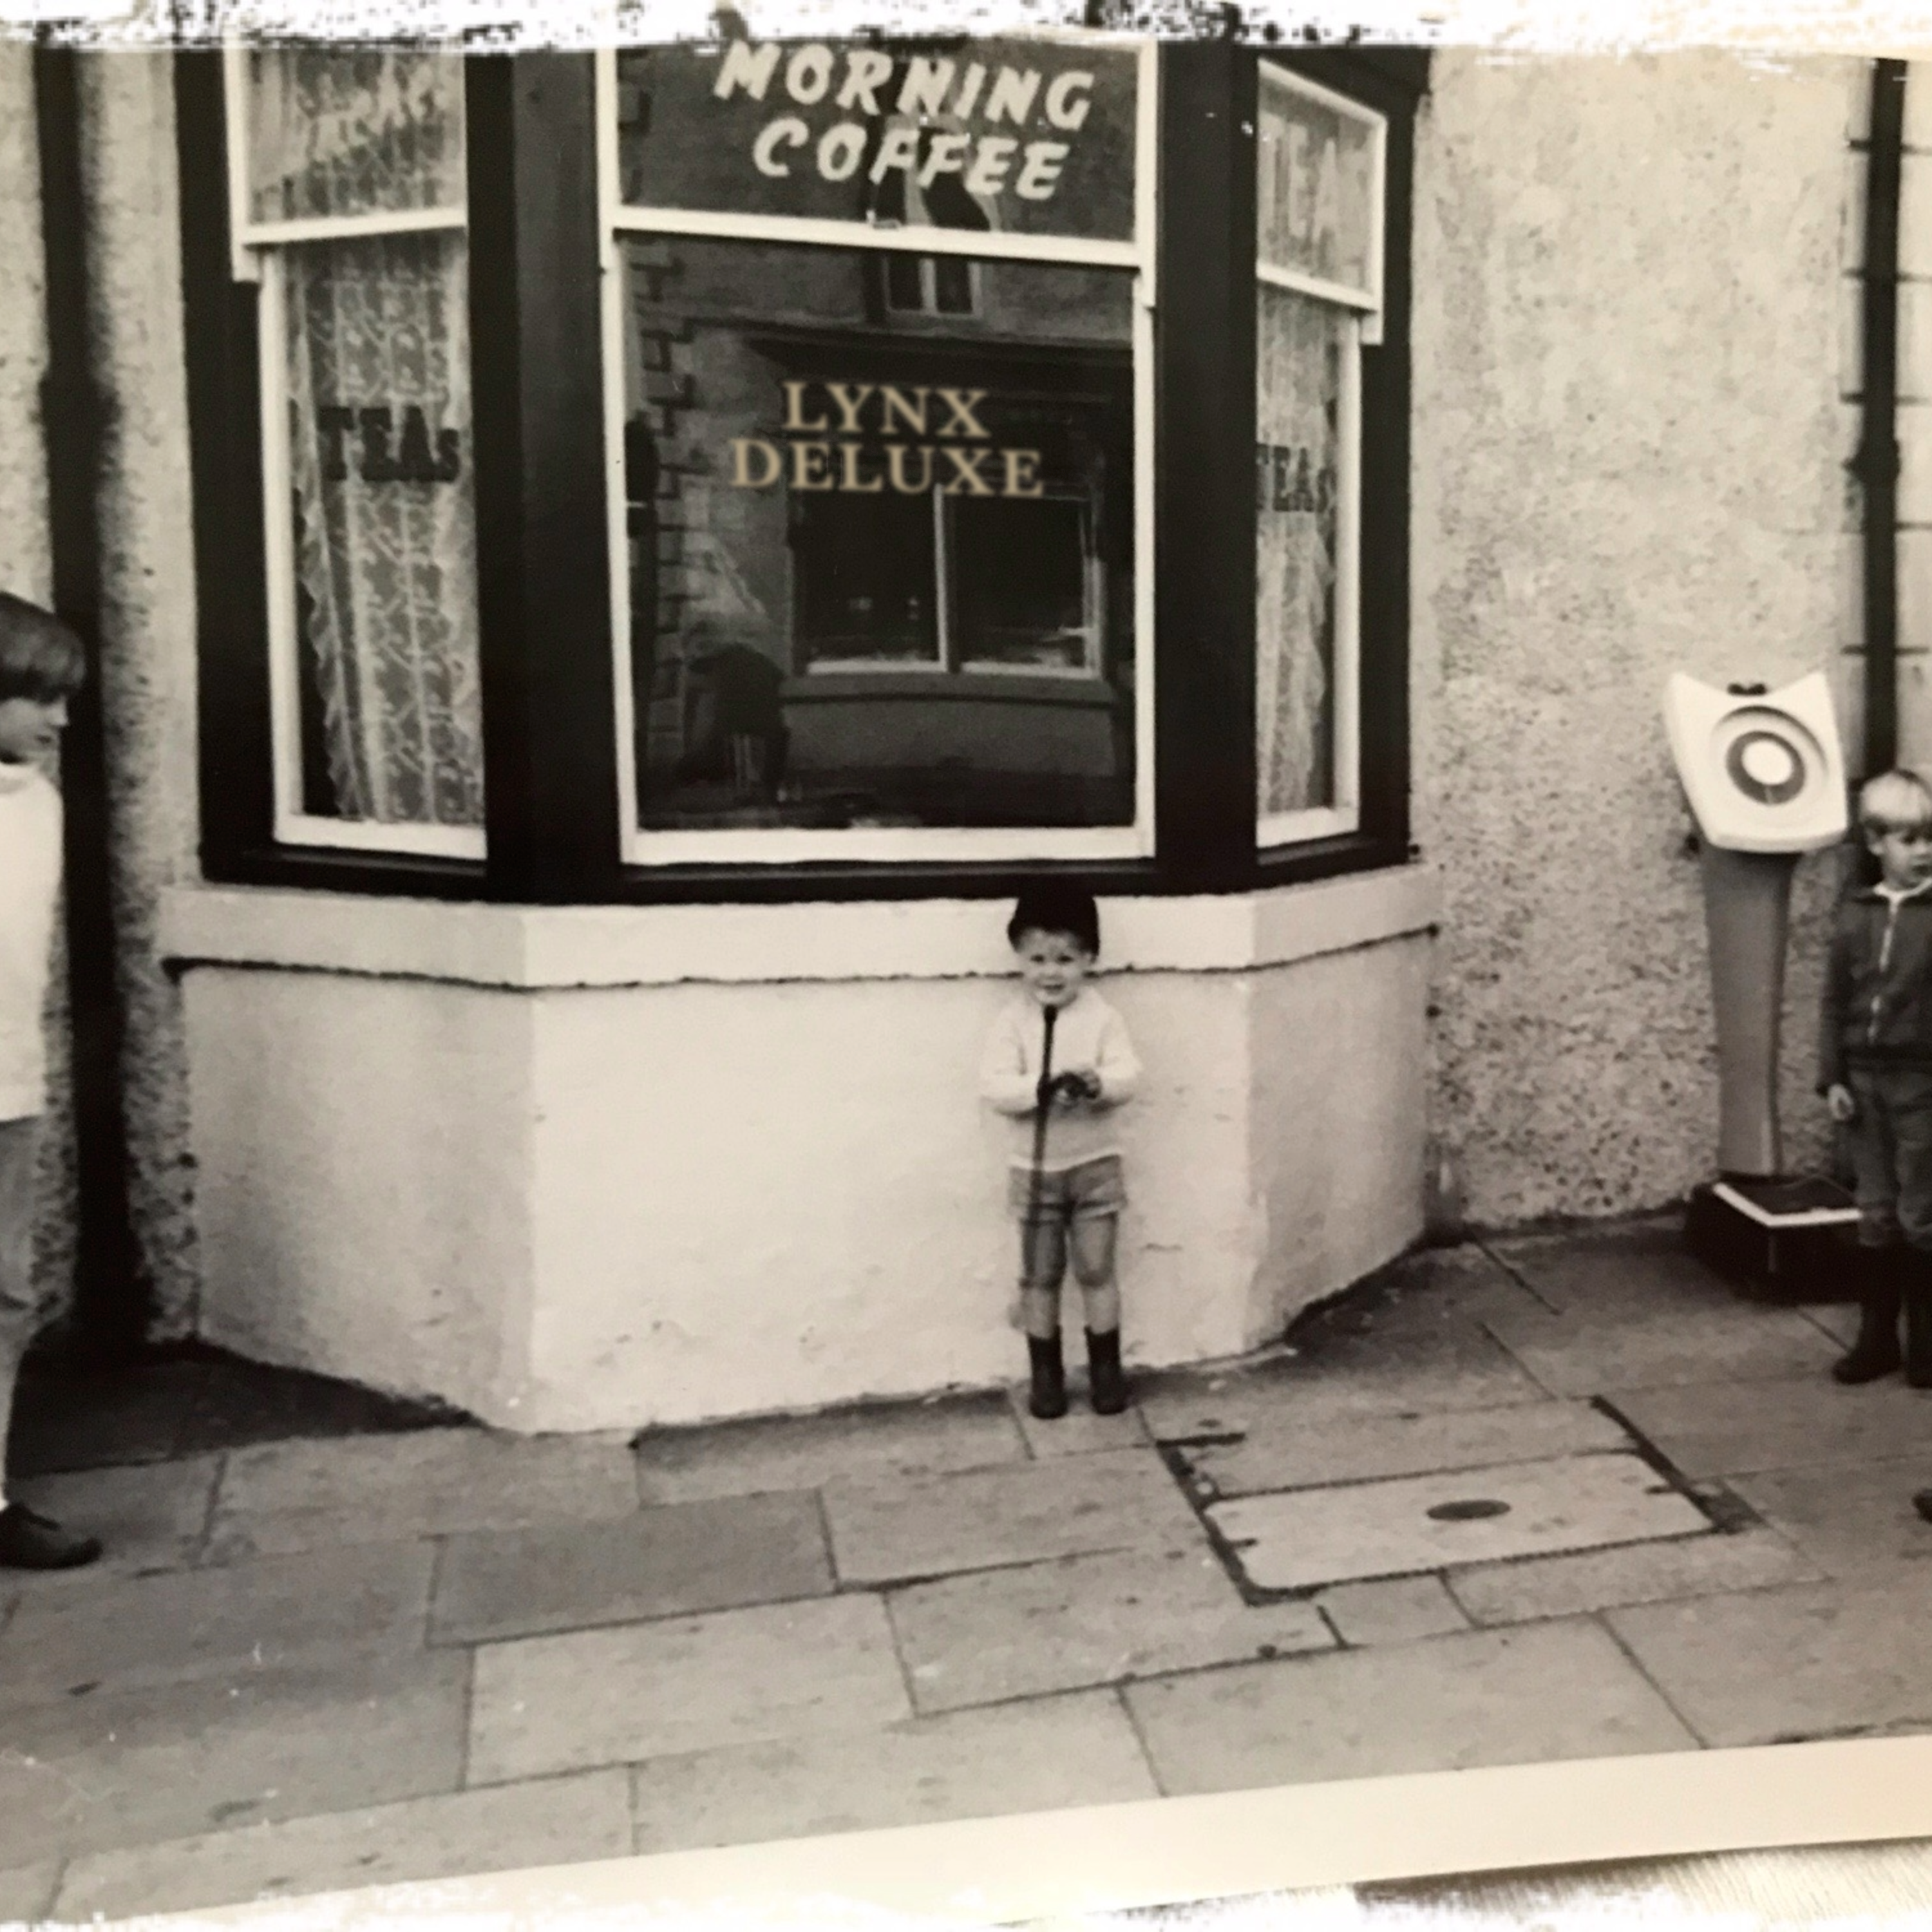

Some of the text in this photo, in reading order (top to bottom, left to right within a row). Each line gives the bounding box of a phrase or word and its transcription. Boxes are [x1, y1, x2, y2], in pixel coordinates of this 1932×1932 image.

[714, 40, 1094, 131] MORNING
[753, 117, 1069, 200] COFFEE
[317, 405, 460, 482] TEAS
